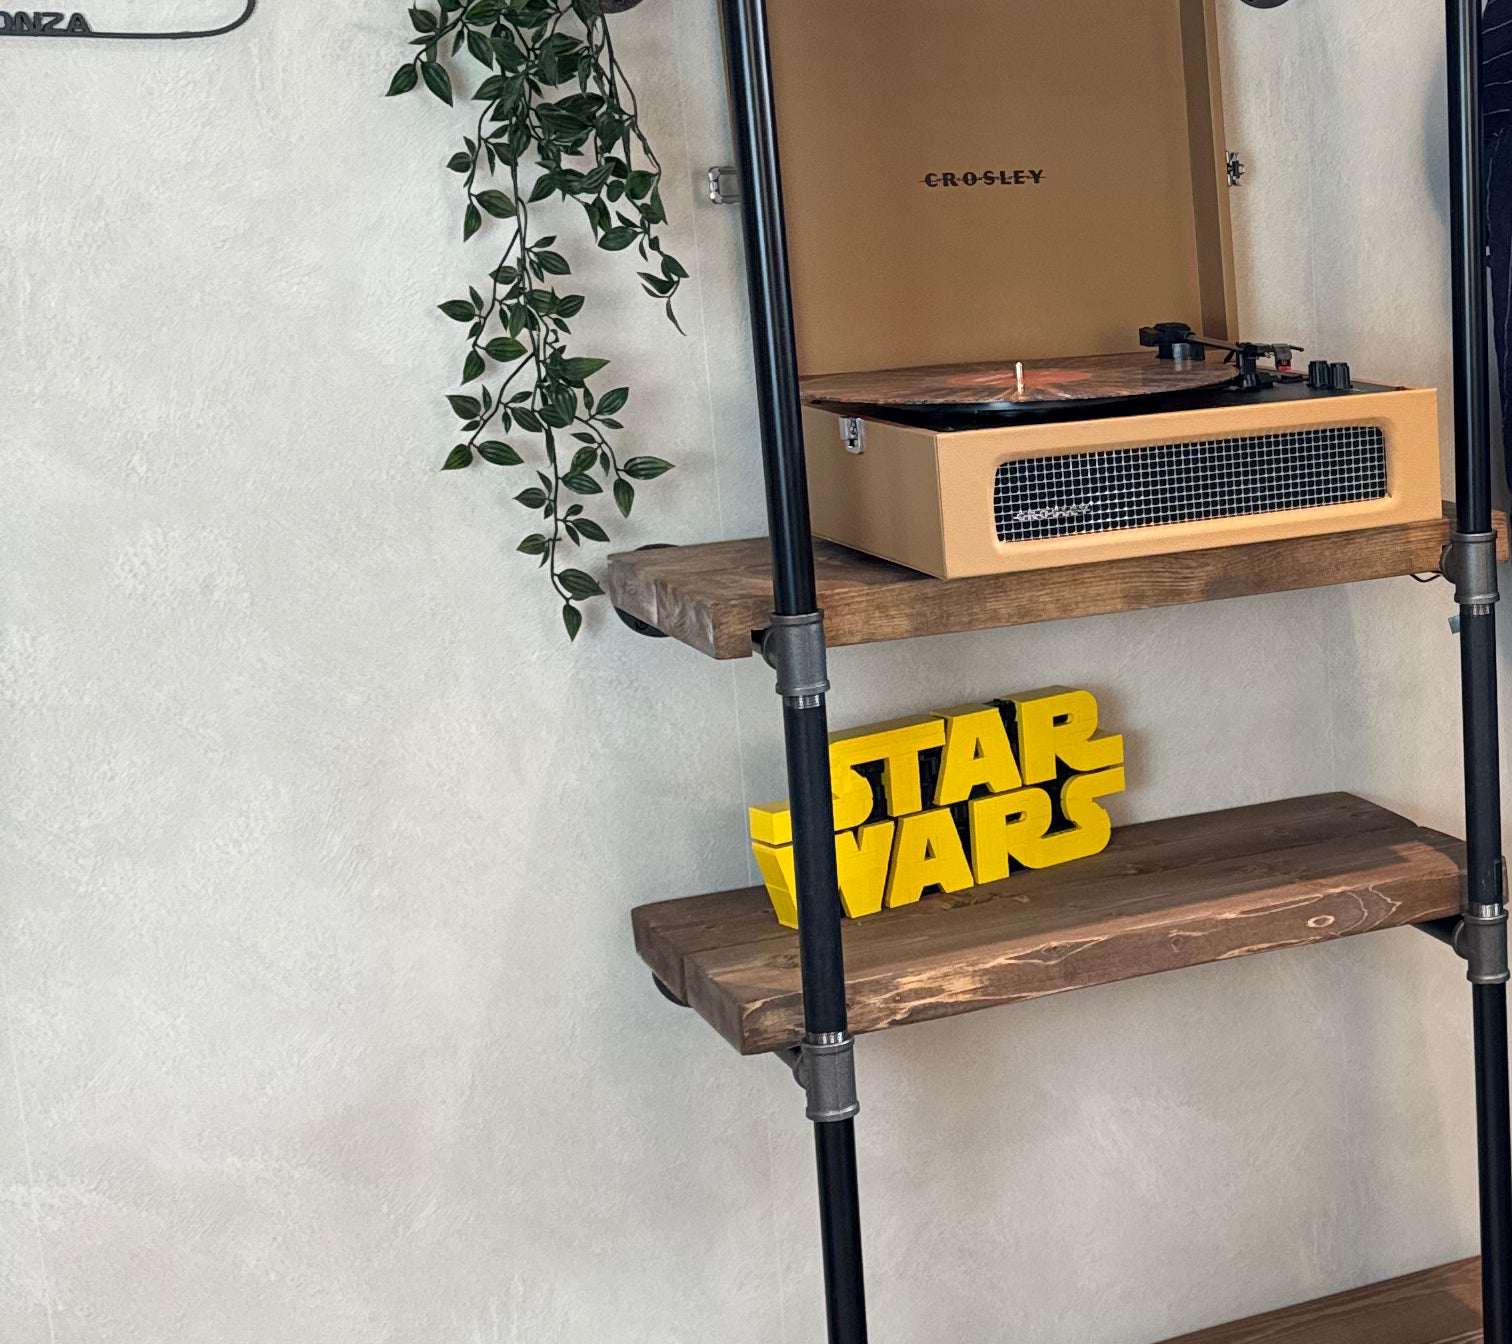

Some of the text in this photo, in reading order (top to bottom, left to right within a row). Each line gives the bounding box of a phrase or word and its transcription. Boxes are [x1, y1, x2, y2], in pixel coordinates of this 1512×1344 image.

[923, 169, 1044, 188] CROSLEY
[750, 684, 1124, 846] STAR
[750, 766, 1126, 930] WARS
